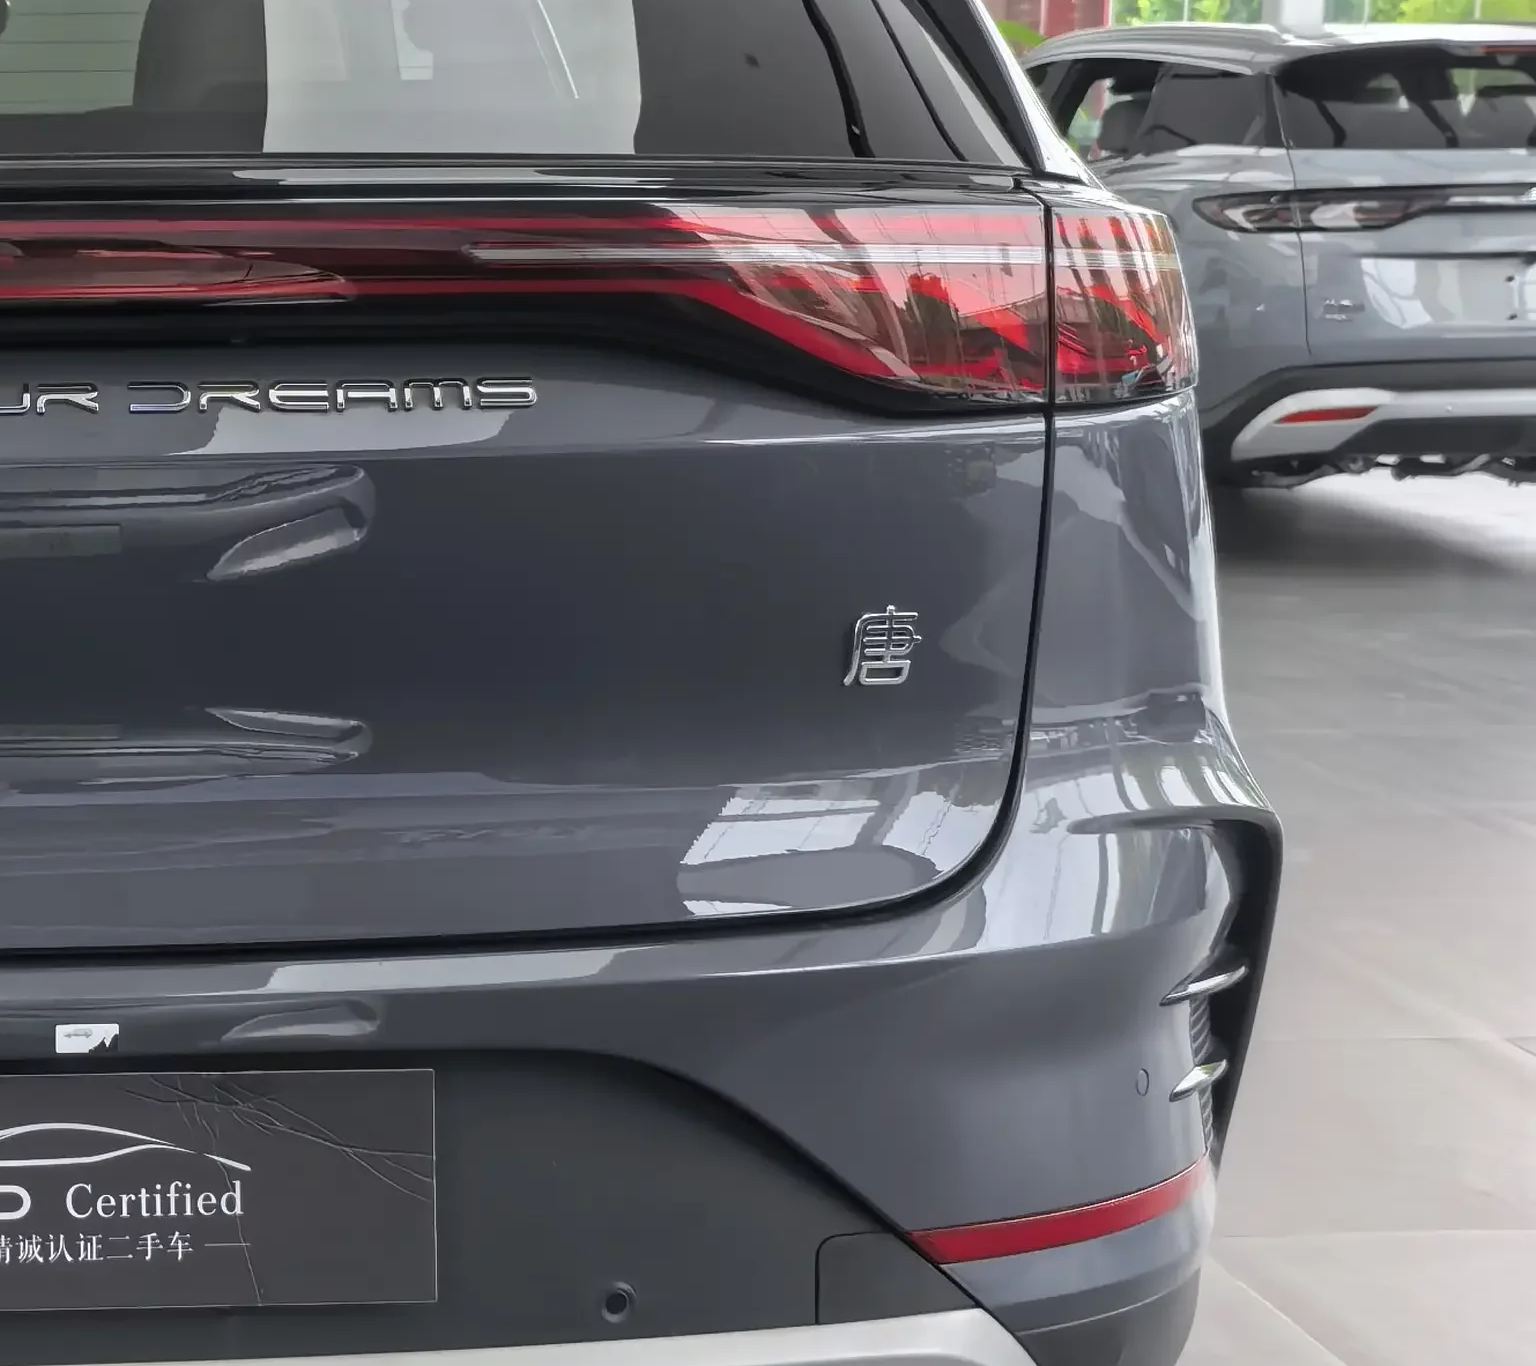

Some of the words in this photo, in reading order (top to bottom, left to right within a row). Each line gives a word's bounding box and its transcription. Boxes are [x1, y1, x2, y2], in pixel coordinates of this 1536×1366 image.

[127, 376, 538, 414] DREAMS
[843, 604, 922, 686] 唐
[65, 1180, 245, 1219] Certified
